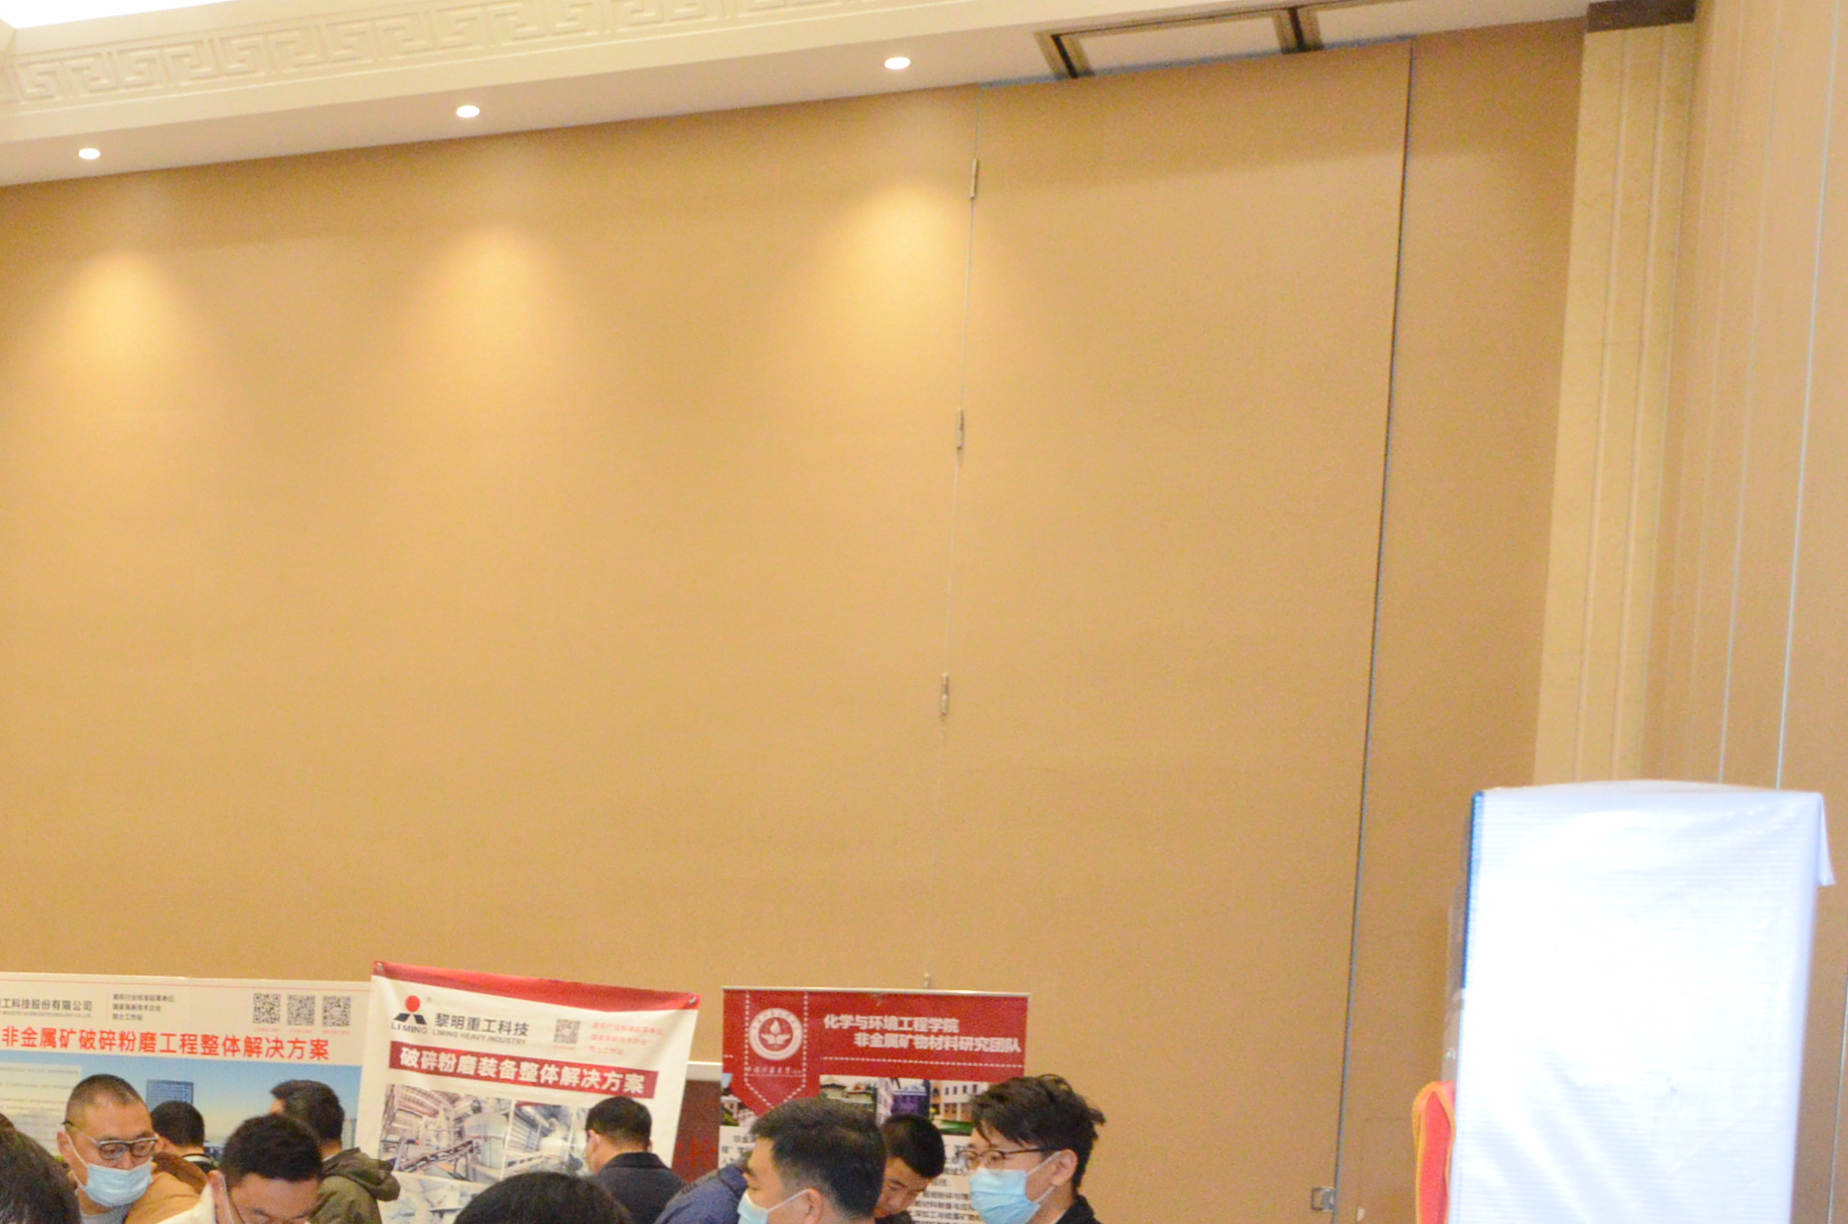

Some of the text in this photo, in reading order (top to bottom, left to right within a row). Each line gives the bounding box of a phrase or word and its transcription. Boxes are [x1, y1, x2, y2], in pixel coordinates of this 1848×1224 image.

[434, 1012, 530, 1037] 黎明重工科技
[823, 1014, 960, 1033] 化学与环境工程学院
[853, 1033, 1022, 1053] 非金属矿物材料研究团队
[399, 1047, 646, 1095] 破碎粉磨装备整体解决方案
